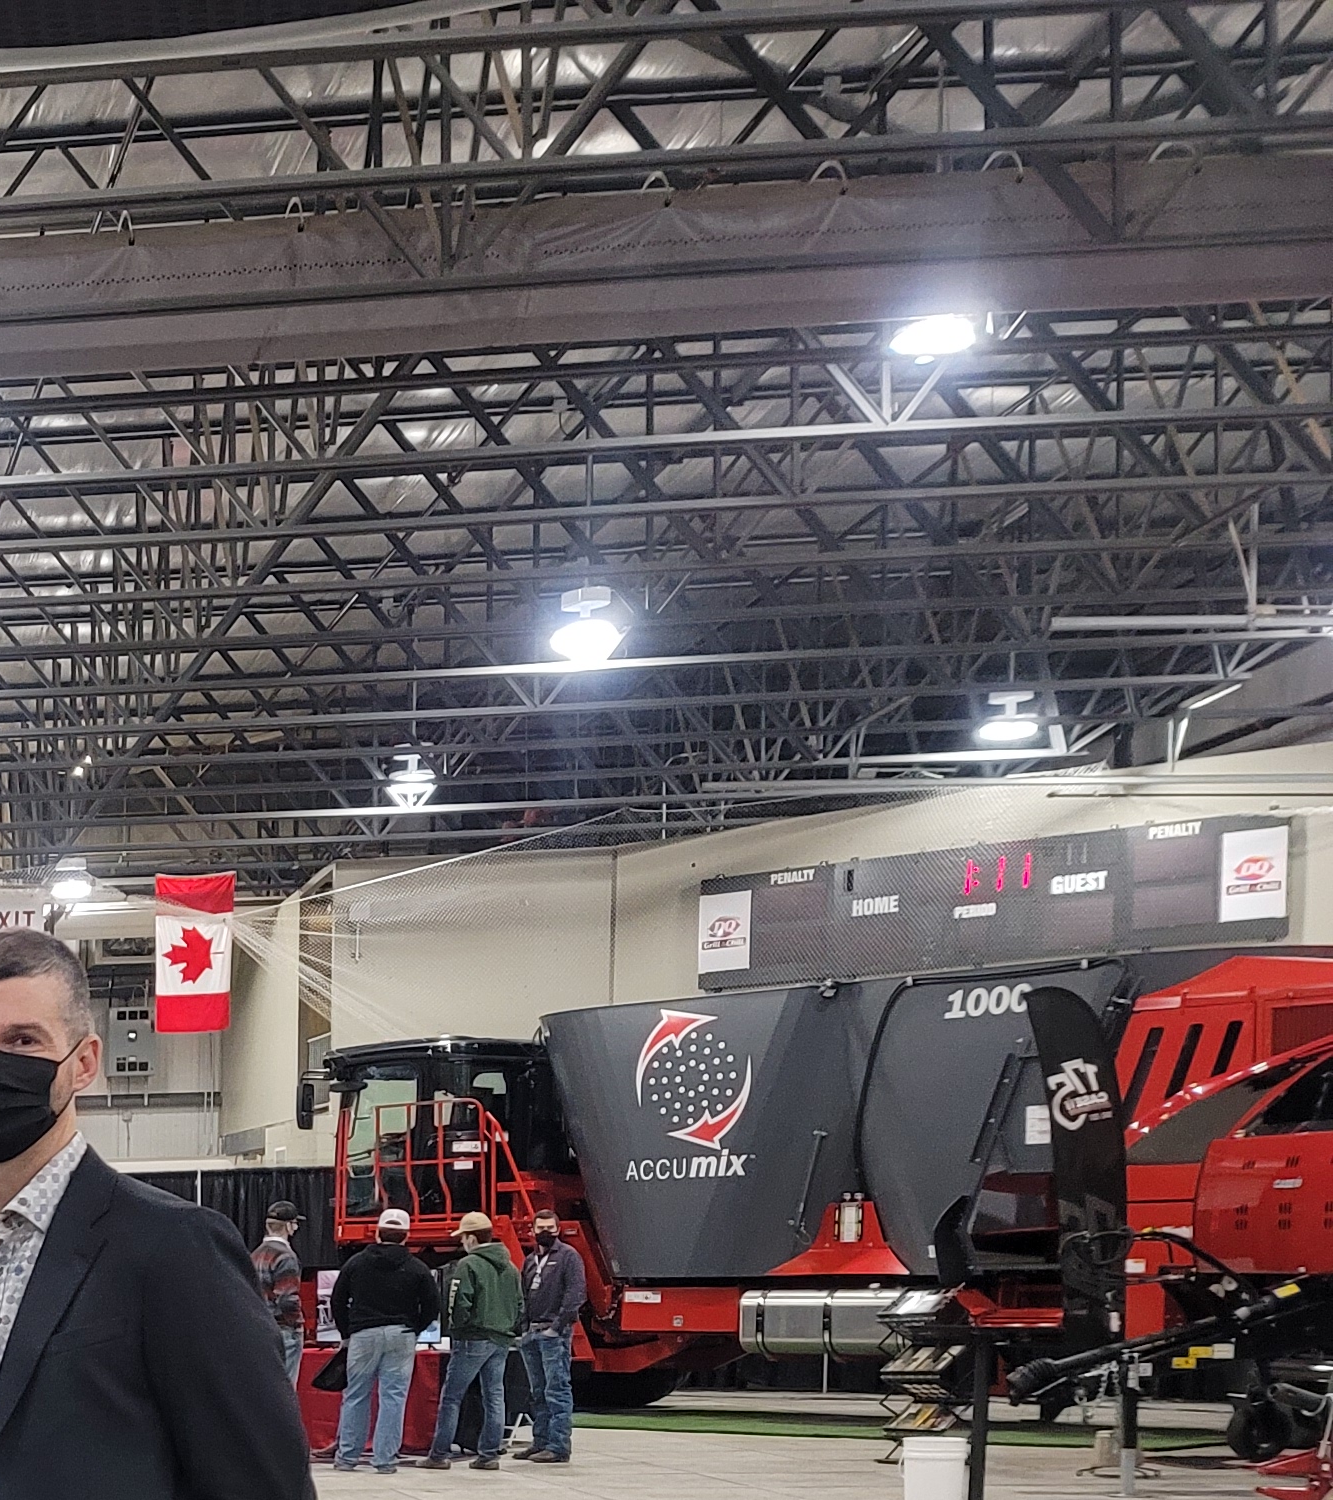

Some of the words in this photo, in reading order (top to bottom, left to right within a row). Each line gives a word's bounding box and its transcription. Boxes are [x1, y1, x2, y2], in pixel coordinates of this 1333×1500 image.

[1148, 821, 1202, 840] PENALTY
[770, 869, 816, 885] PENALTY
[1050, 870, 1108, 894] GUEST
[851, 895, 900, 918] HOME
